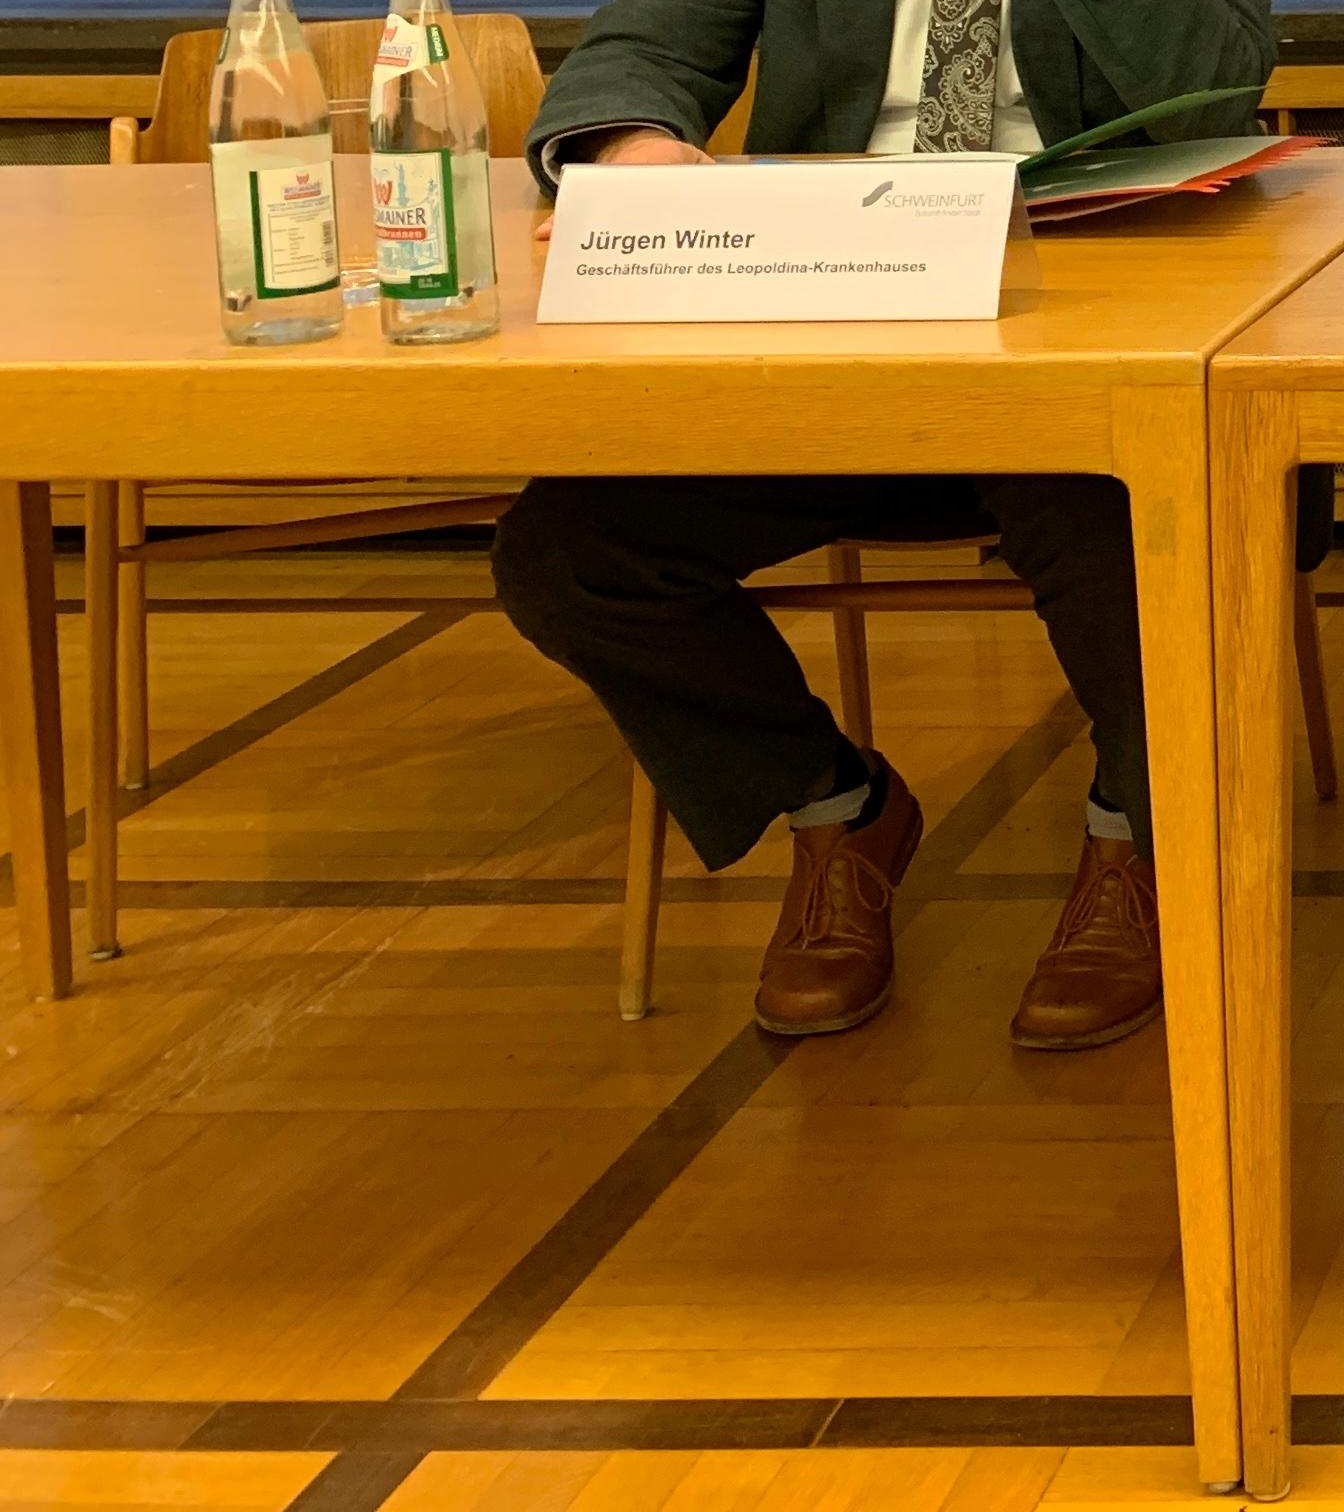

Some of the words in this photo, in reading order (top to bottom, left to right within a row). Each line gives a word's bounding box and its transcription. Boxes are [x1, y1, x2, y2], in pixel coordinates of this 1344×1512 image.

[884, 193, 986, 208] SCHWEINFURT
[580, 231, 666, 255] Jürgen
[675, 229, 756, 249] Winter
[576, 262, 694, 276] Geschäftsführer
[697, 262, 723, 275] des
[727, 260, 928, 276] Leopoldina-Krankenhauses
